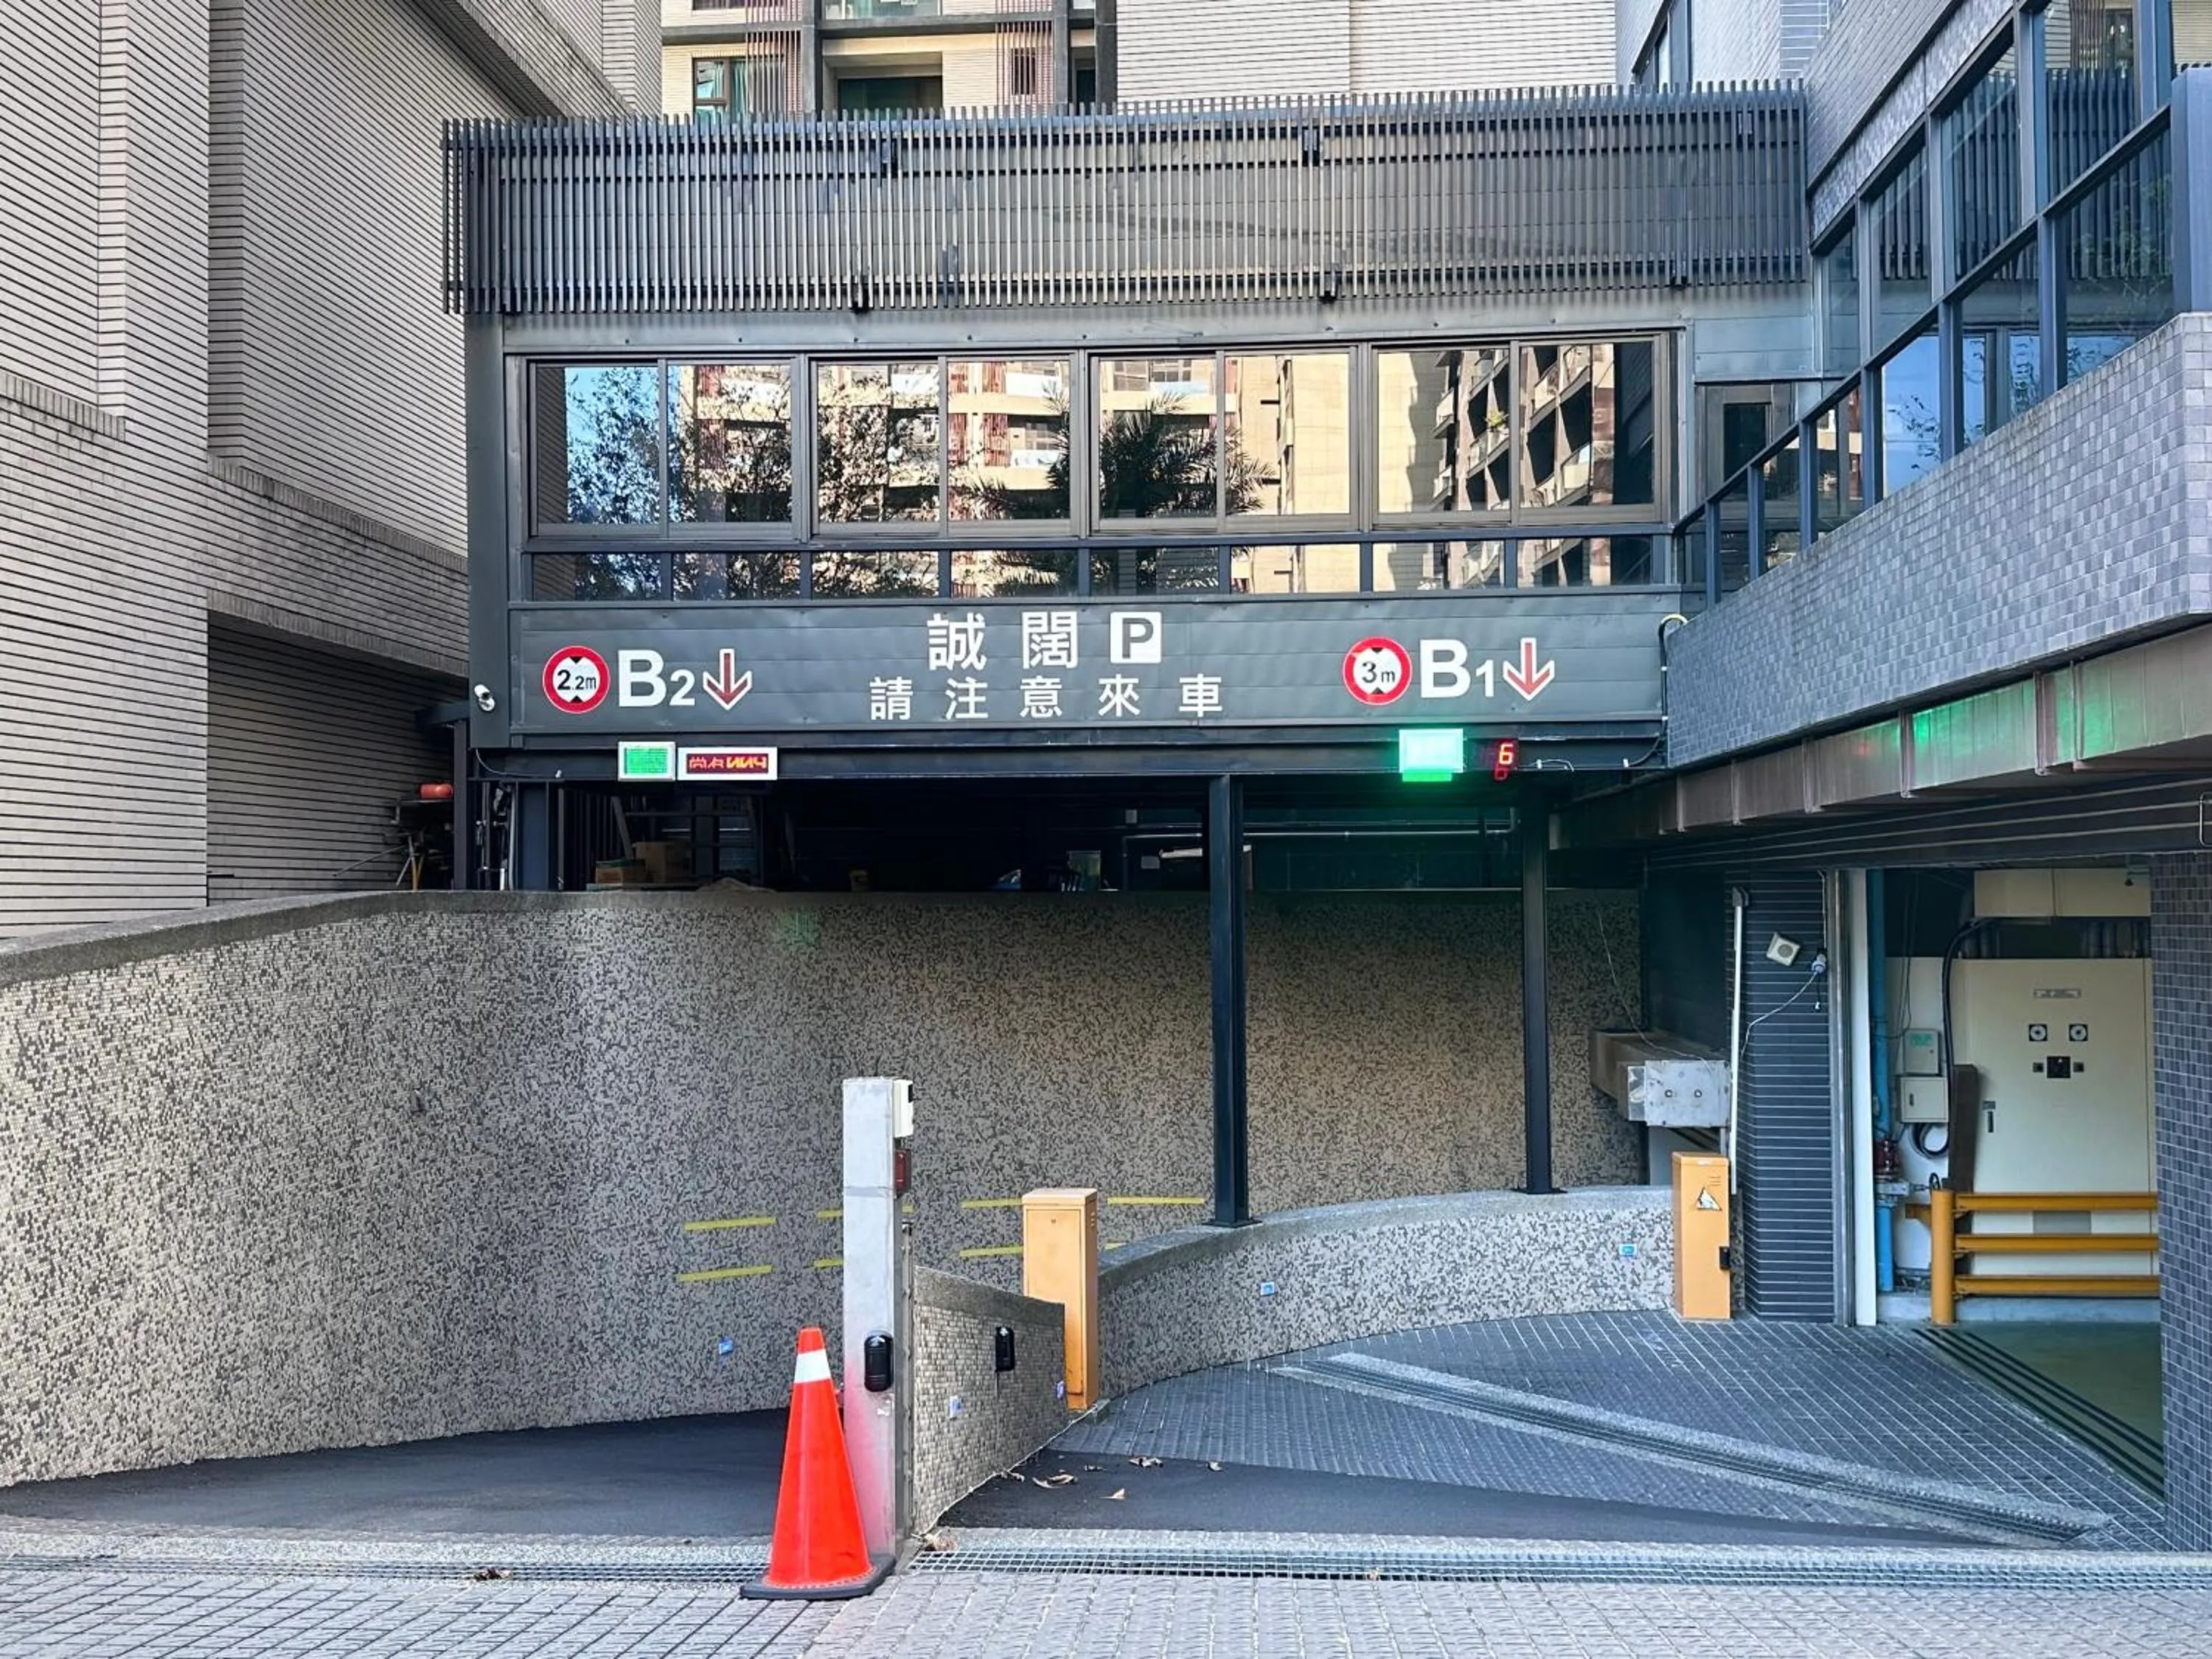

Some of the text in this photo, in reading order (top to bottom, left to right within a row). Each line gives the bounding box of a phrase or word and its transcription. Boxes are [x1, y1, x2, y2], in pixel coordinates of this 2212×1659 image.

[927, 611, 1156, 670] 誠闊 P
[1420, 639, 1495, 698] B1
[557, 669, 597, 691] 2.2m
[618, 650, 695, 707] B2
[869, 672, 1223, 721] 請注意來車
